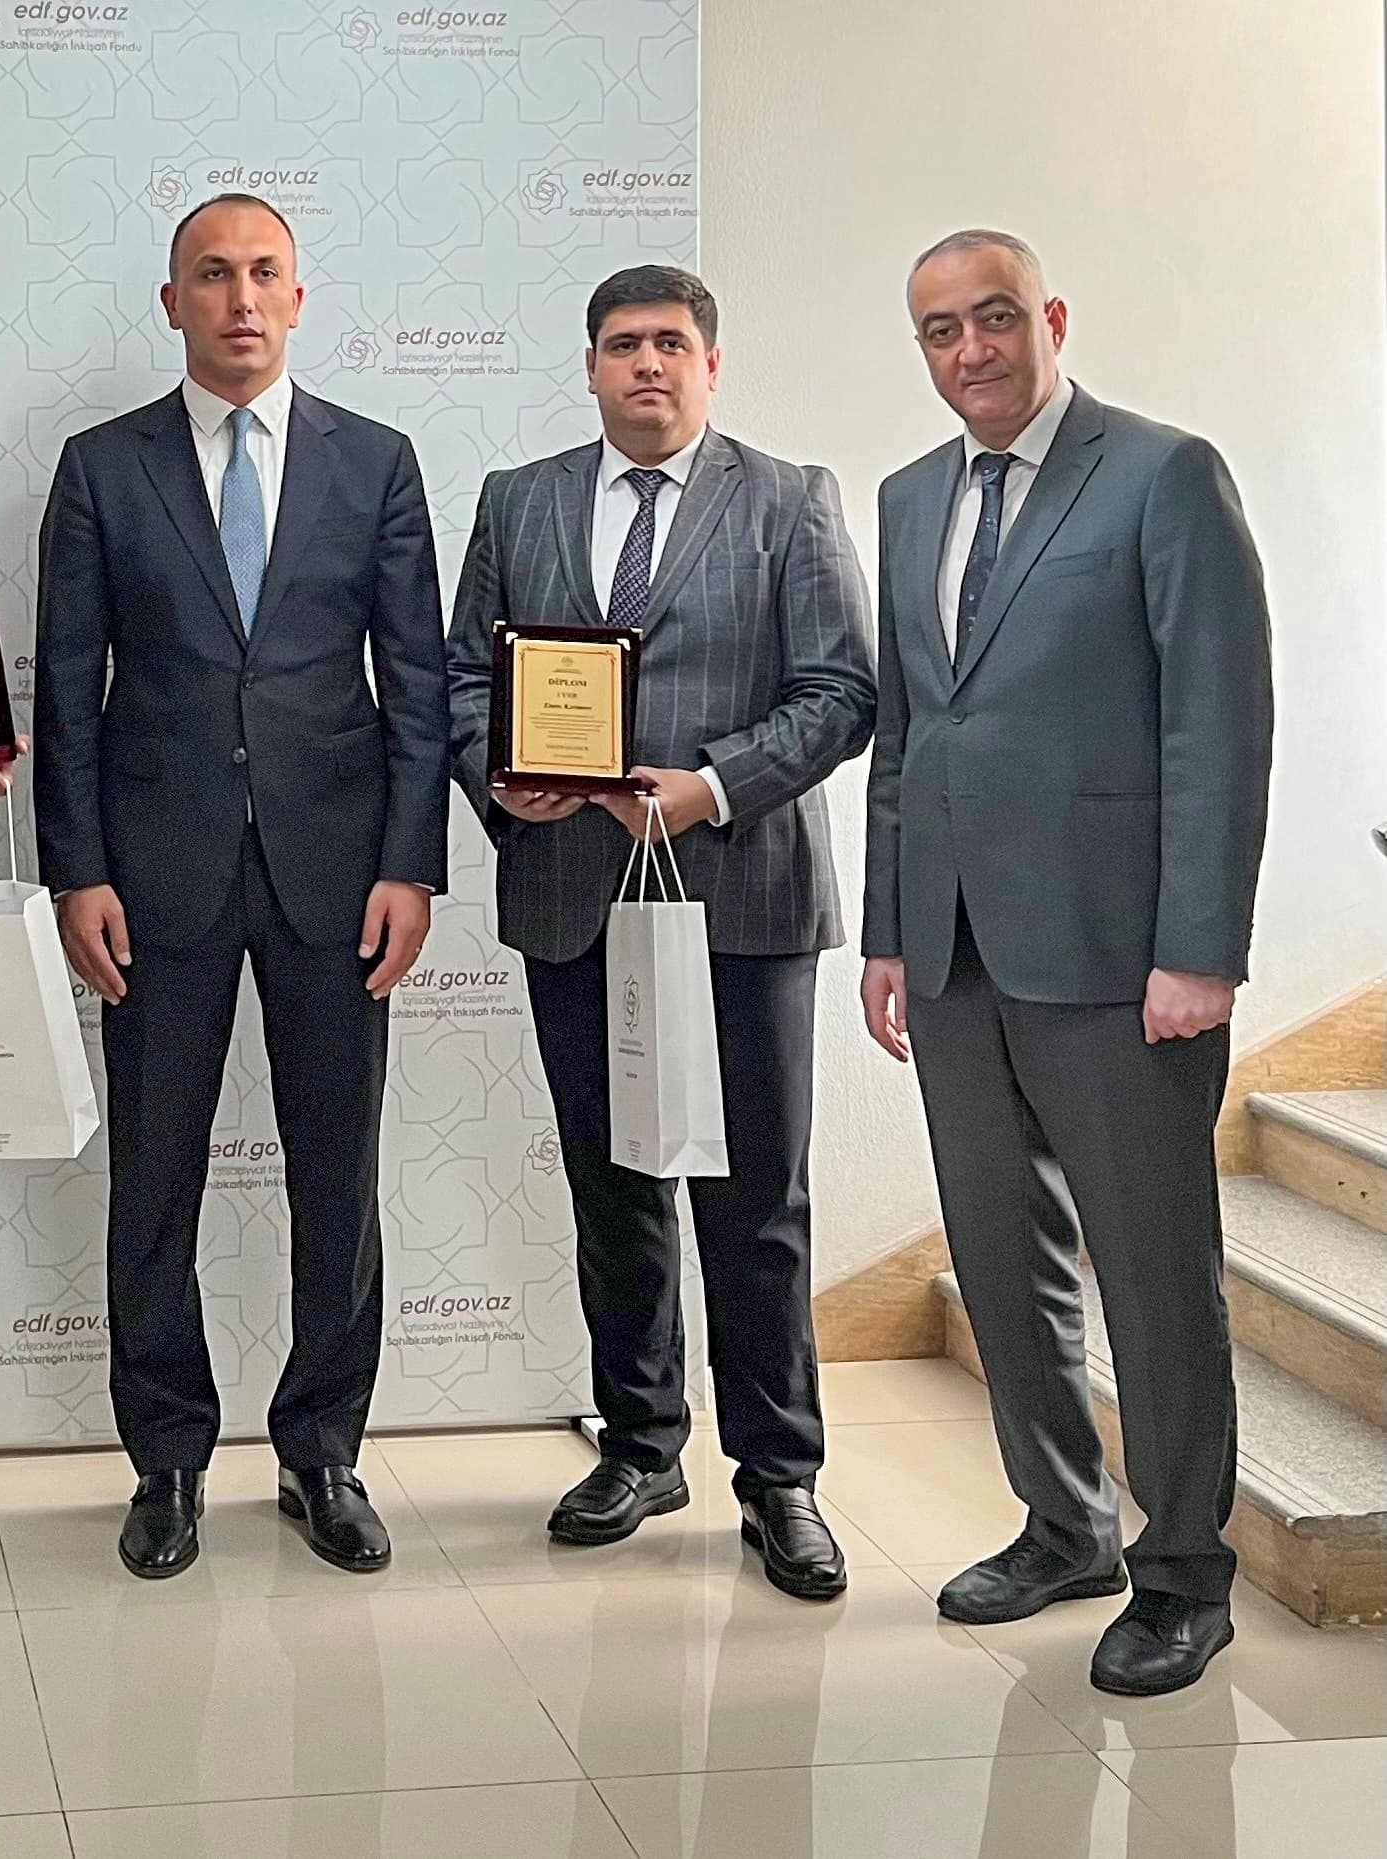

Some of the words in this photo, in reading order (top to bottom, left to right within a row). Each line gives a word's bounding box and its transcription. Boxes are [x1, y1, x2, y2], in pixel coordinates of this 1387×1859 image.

[13, 1, 129, 24] edf.gov.az
[397, 8, 507, 30] edf.gov.az
[207, 167, 318, 188] edf.gov.az
[583, 169, 692, 190] edf.gov.az
[673, 208, 698, 217] Fond
[396, 328, 506, 349] edf.gov.az
[399, 969, 509, 991] edf.gov.az
[209, 1138, 279, 1161] edf.go
[400, 1295, 512, 1317] edf.gov.az
[13, 1313, 109, 1336] edf.gov.
